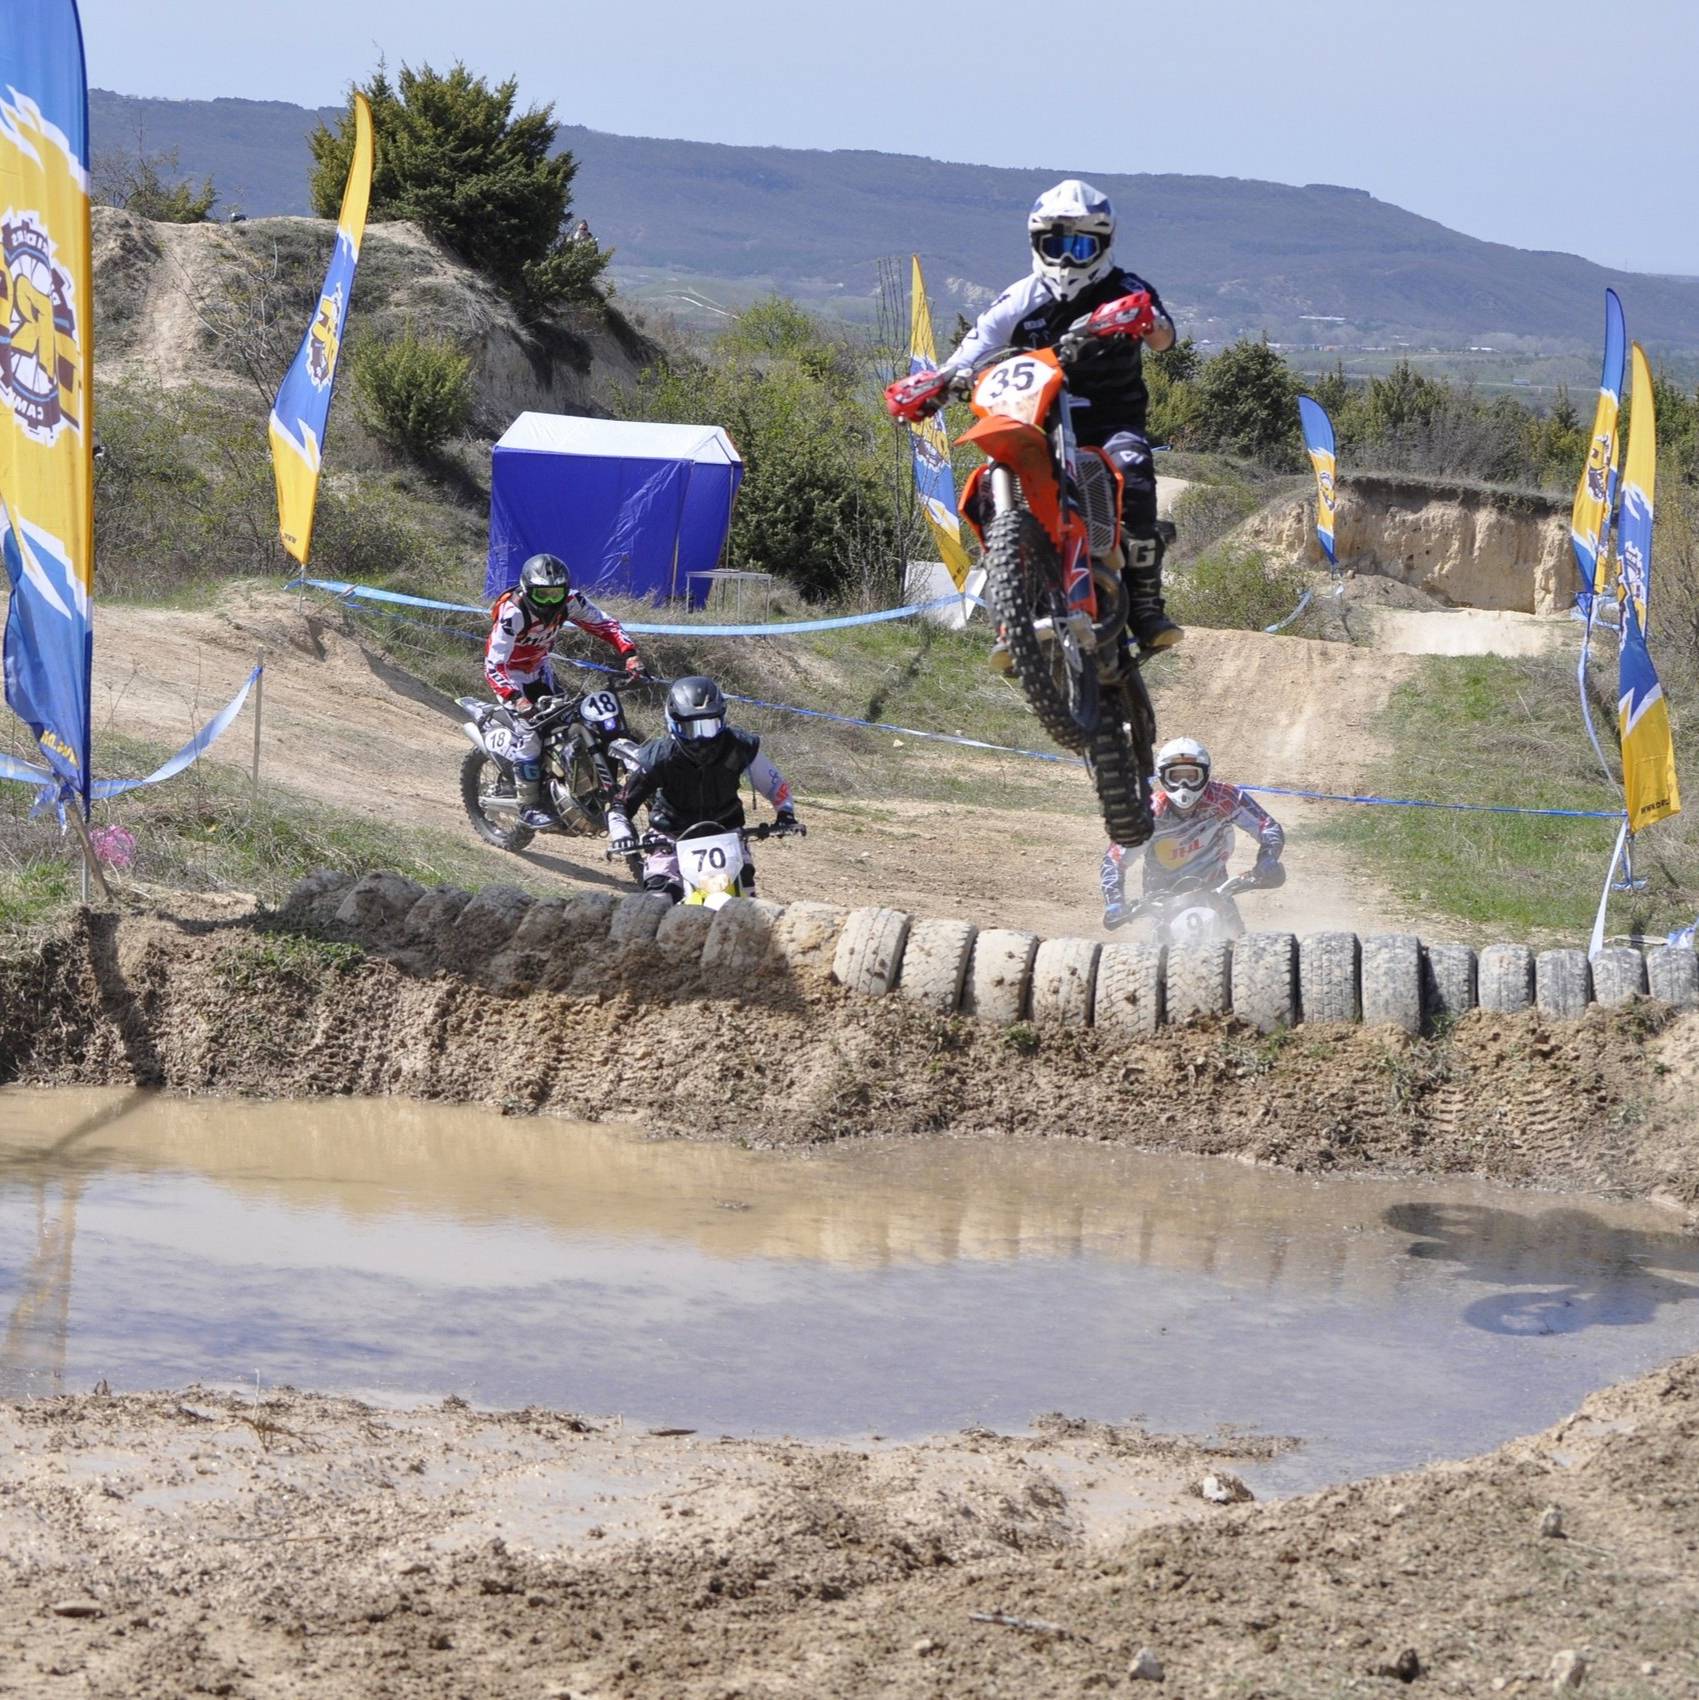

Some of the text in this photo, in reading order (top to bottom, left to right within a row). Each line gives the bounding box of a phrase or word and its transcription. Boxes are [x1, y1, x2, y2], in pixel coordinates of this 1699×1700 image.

[990, 362, 1035, 398] 35
[588, 693, 616, 716] 18
[490, 731, 506, 748] 18
[691, 847, 726, 872] 70
[1187, 912, 1203, 938] 9
